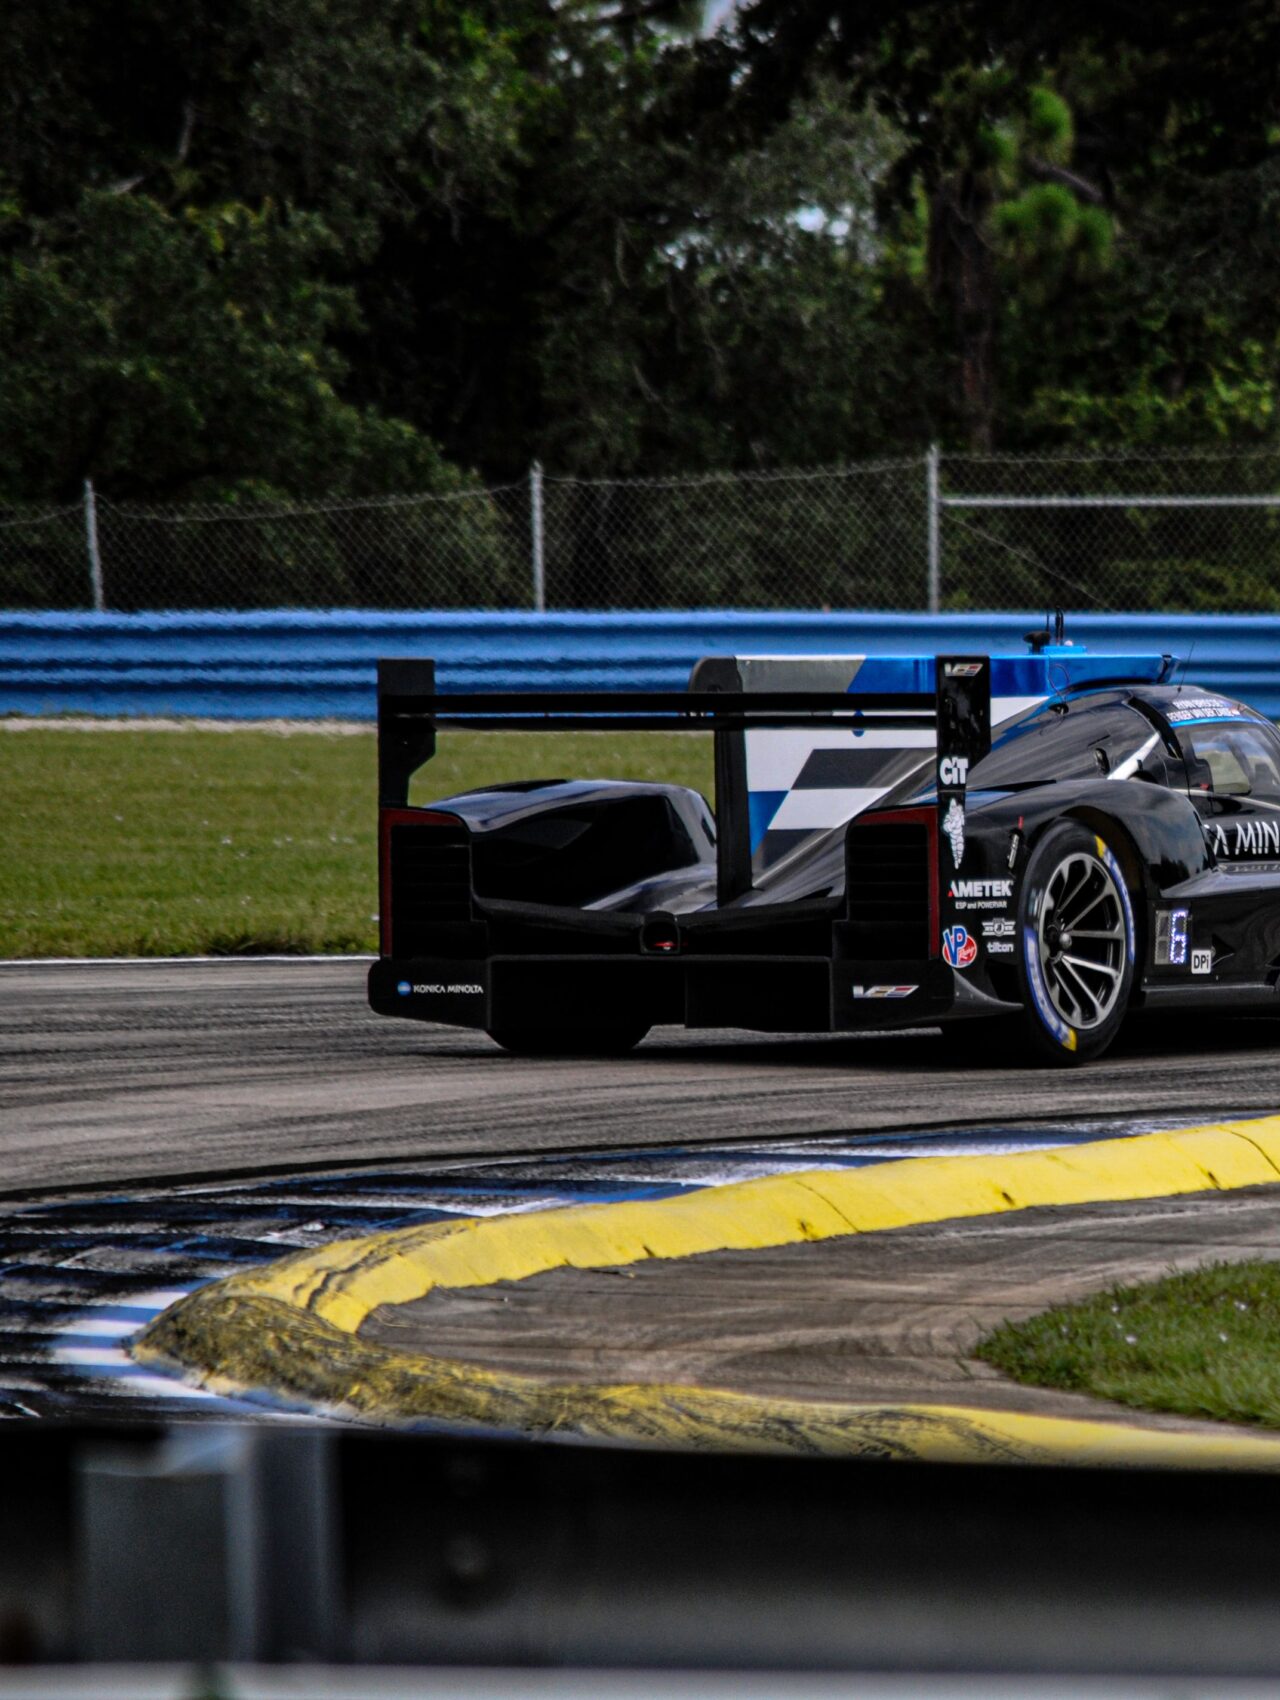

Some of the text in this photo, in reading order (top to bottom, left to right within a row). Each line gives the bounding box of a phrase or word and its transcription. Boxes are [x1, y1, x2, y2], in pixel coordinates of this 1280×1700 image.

[948, 880, 1013, 897] AMETEK
[967, 902, 977, 910] and
[1193, 954, 1210, 970] DPi
[413, 984, 484, 994] KONICA MINOLTA
